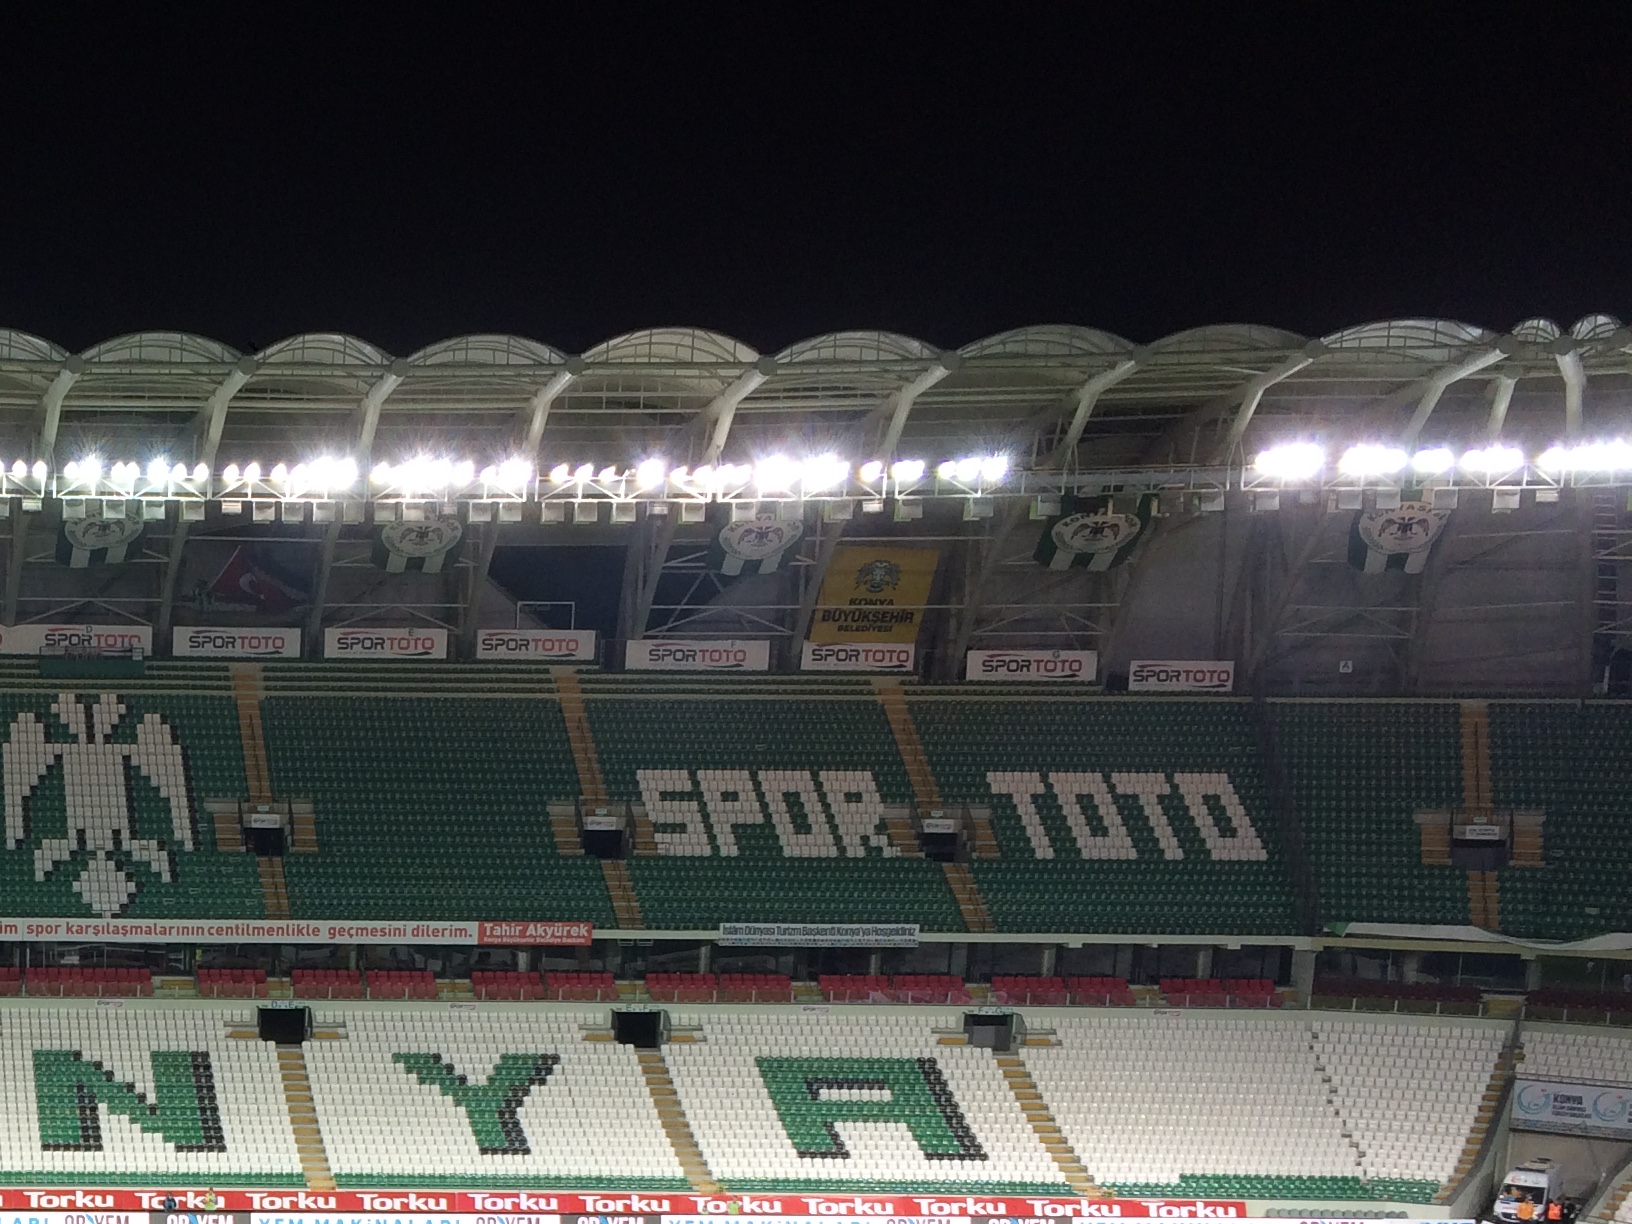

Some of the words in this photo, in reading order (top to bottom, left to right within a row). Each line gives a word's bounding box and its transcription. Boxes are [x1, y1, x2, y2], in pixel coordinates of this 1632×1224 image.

[636, 768, 902, 858] SPOR
[985, 771, 1269, 861] TOTO
[26, 922, 61, 938] spor
[65, 921, 205, 939] karşılaşmalarının
[207, 922, 321, 937] centilmenlikle
[327, 923, 407, 940] geçmesini
[411, 923, 473, 938] dilerim.
[483, 922, 521, 936] Tahir
[525, 923, 589, 939] Akyürek
[23, 1190, 114, 1208] Torku
[245, 1191, 336, 1209] Torku
[356, 1192, 447, 1210] Torku
[467, 1192, 558, 1210] Torku
[578, 1195, 671, 1213] Torku
[688, 1195, 781, 1213] Toku
[801, 1197, 894, 1215] Torku
[912, 1197, 1006, 1216] Torku
[1026, 1199, 1121, 1217] Torku
[1141, 1201, 1238, 1218] Torku
